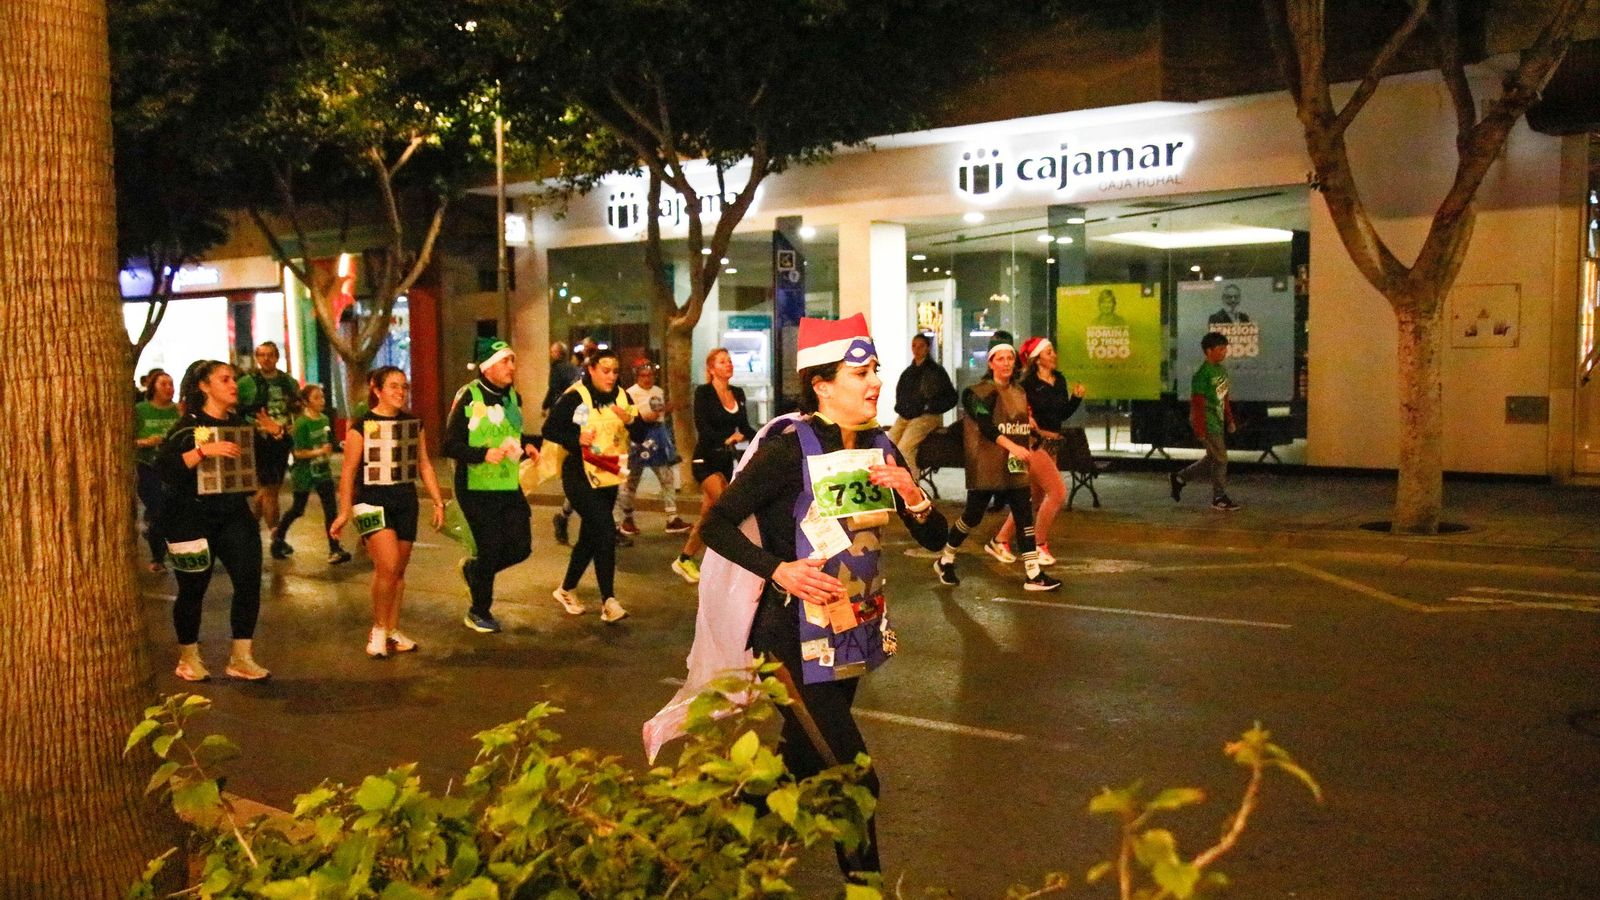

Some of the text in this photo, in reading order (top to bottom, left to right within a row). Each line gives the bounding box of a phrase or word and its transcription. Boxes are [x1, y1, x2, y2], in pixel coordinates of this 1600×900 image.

[1016, 142, 1184, 191] cajamar
[1087, 345, 1131, 359] TODO
[828, 481, 882, 507] 733
